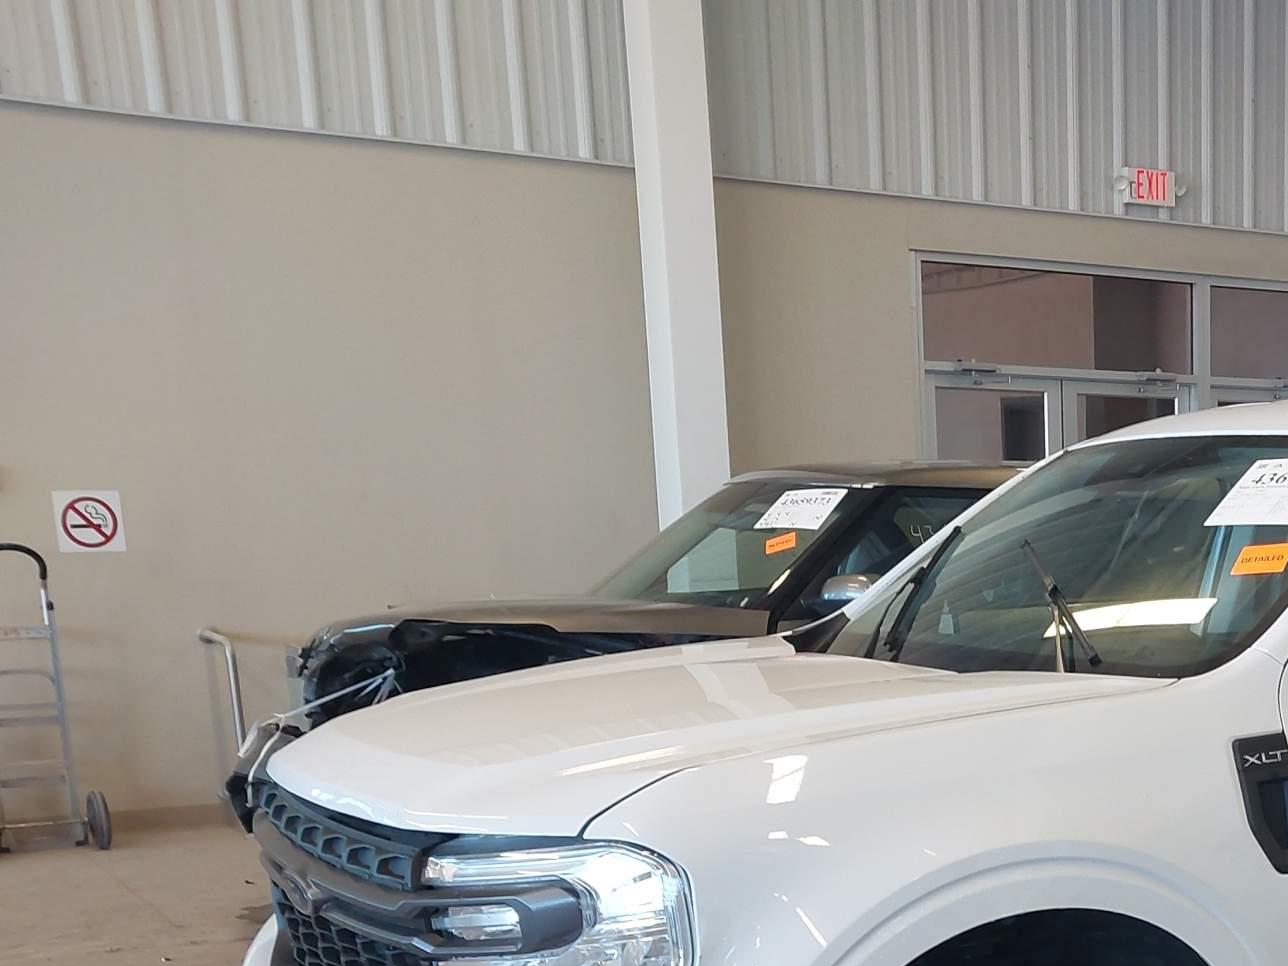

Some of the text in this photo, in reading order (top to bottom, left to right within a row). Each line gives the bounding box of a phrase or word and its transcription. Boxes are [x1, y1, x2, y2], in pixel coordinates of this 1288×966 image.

[1136, 169, 1168, 201] EXIT
[1240, 554, 1286, 565] DETAILED
[1243, 749, 1288, 768] XLT
